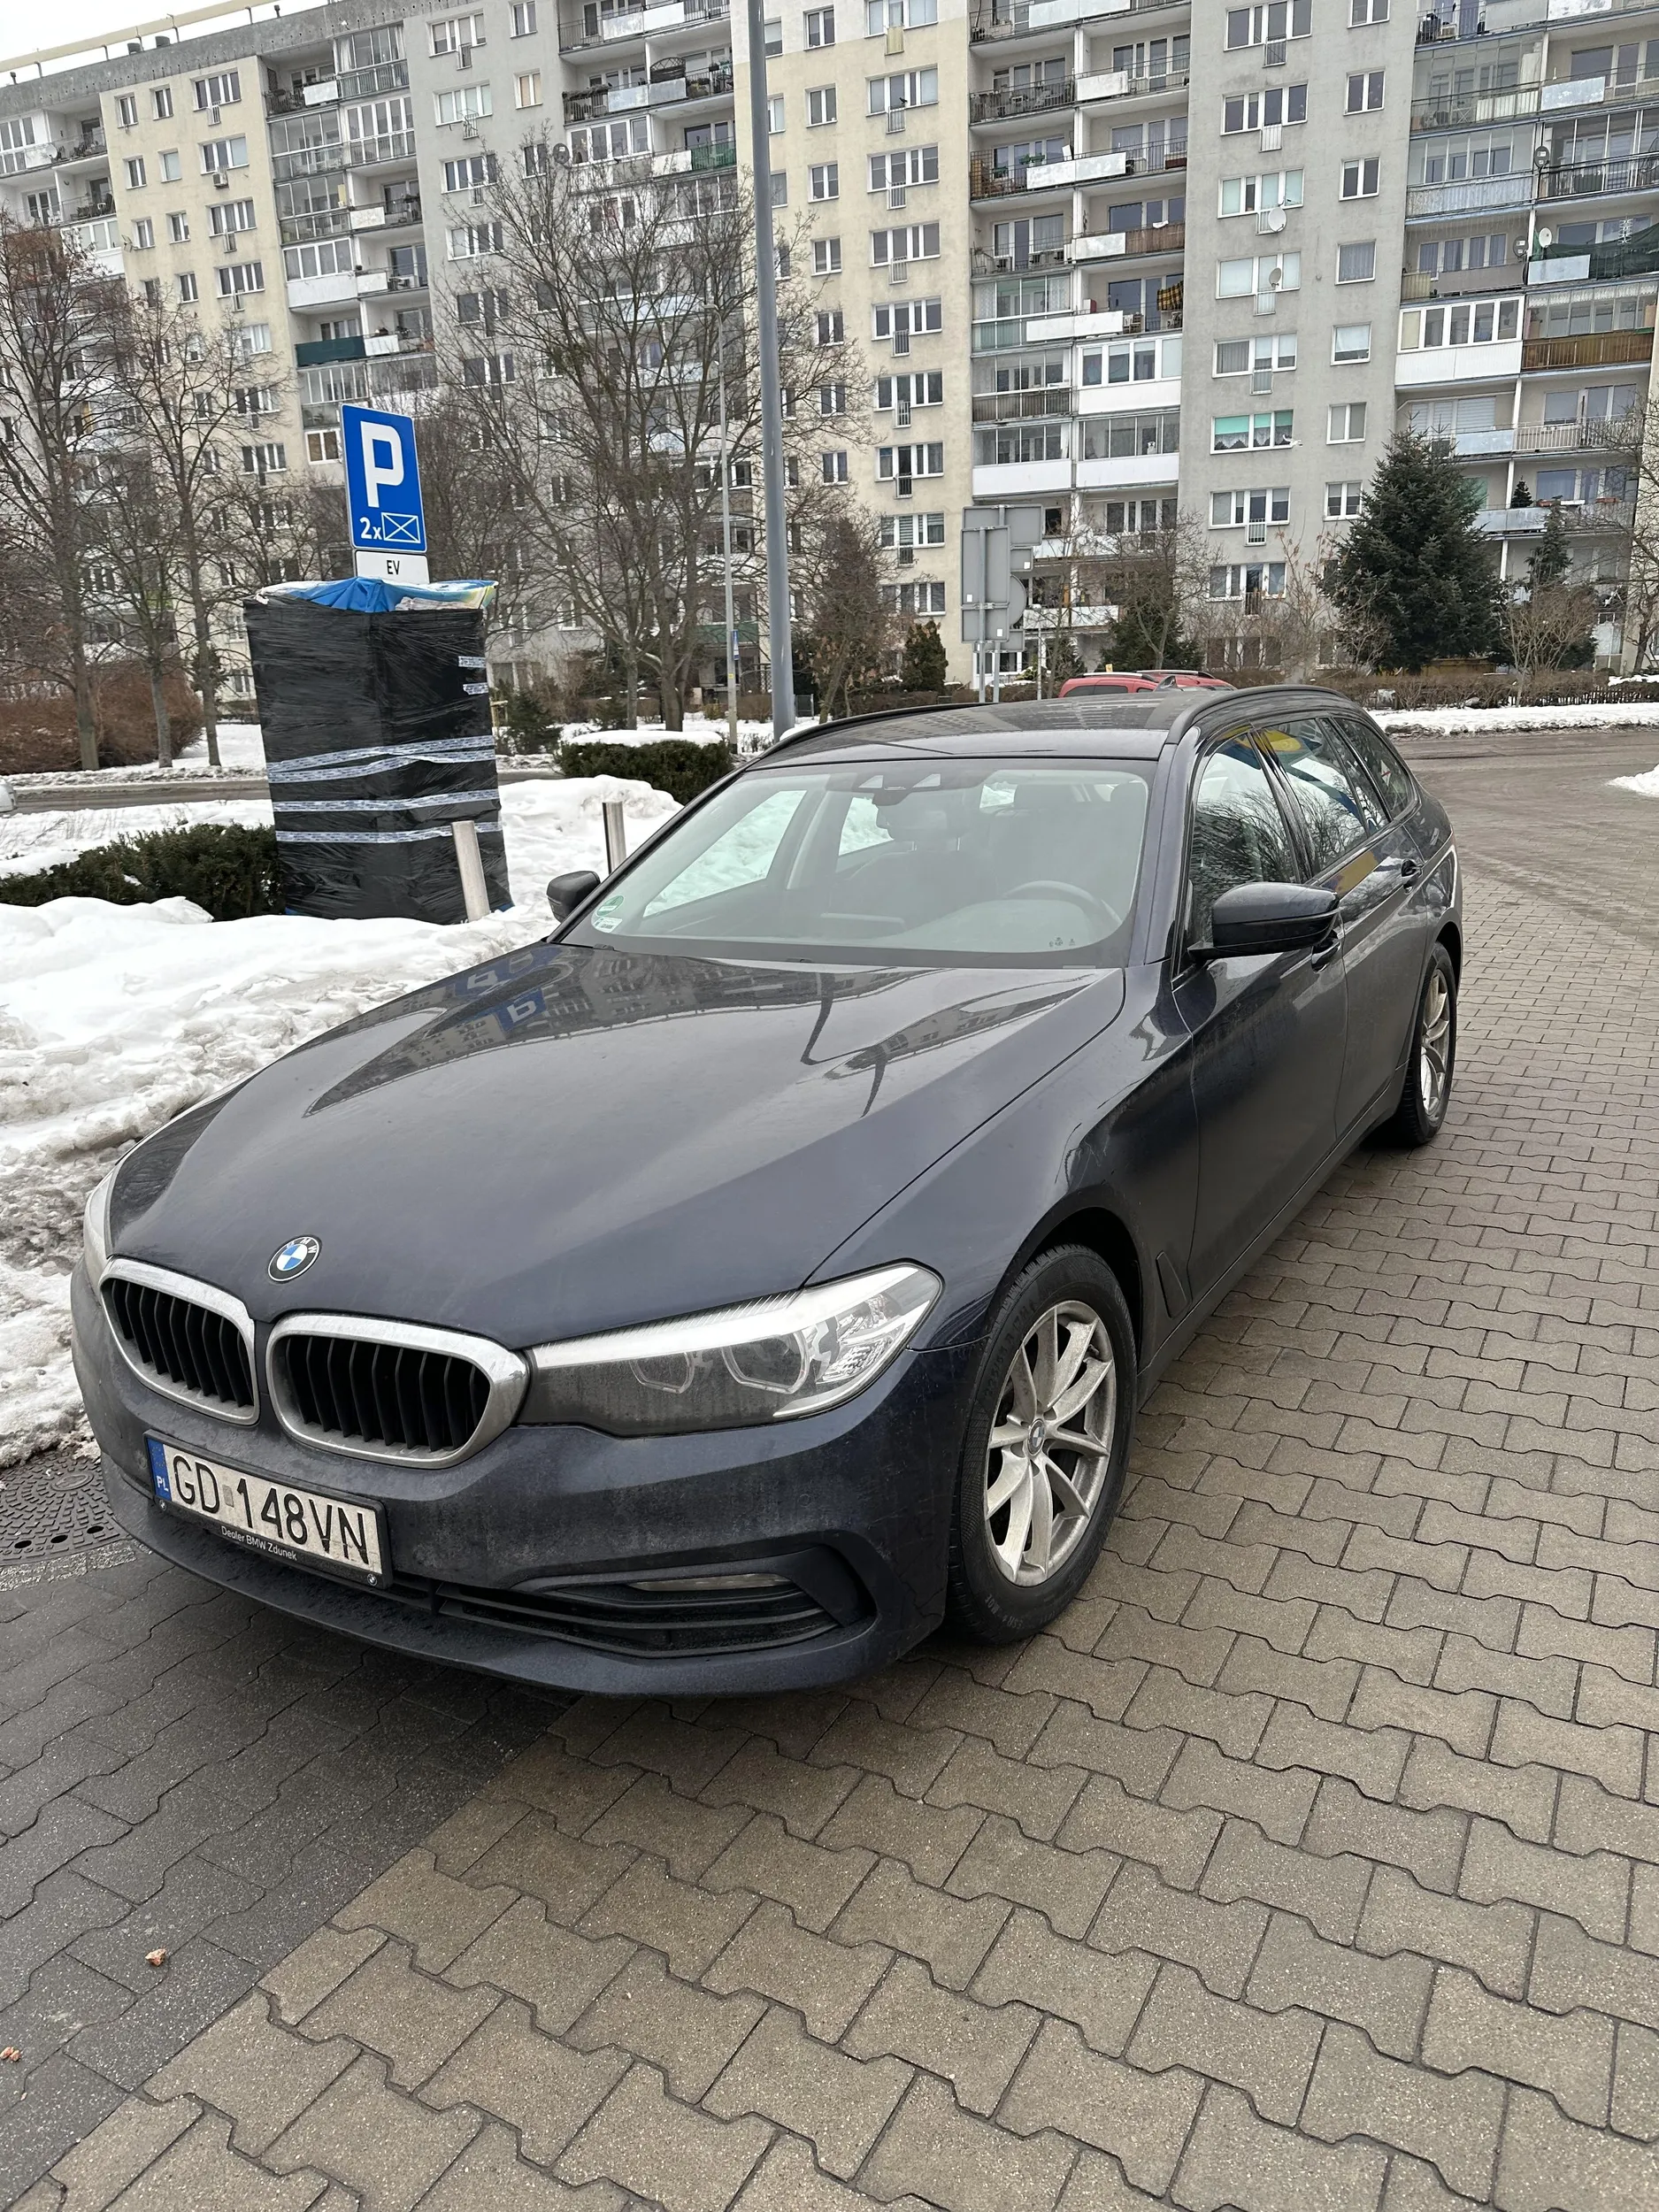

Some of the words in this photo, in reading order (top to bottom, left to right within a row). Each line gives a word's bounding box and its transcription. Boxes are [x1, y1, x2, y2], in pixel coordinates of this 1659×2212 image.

[360, 420, 404, 509] P
[359, 516, 382, 541] 2x
[387, 559, 400, 575] EV
[156, 1475, 169, 1493] PL
[173, 1455, 220, 1514] GD
[236, 1478, 370, 1564] 148VN
[221, 1525, 245, 1542] Dealer
[246, 1534, 266, 1551] BMW
[267, 1543, 297, 1562] Zdunek
